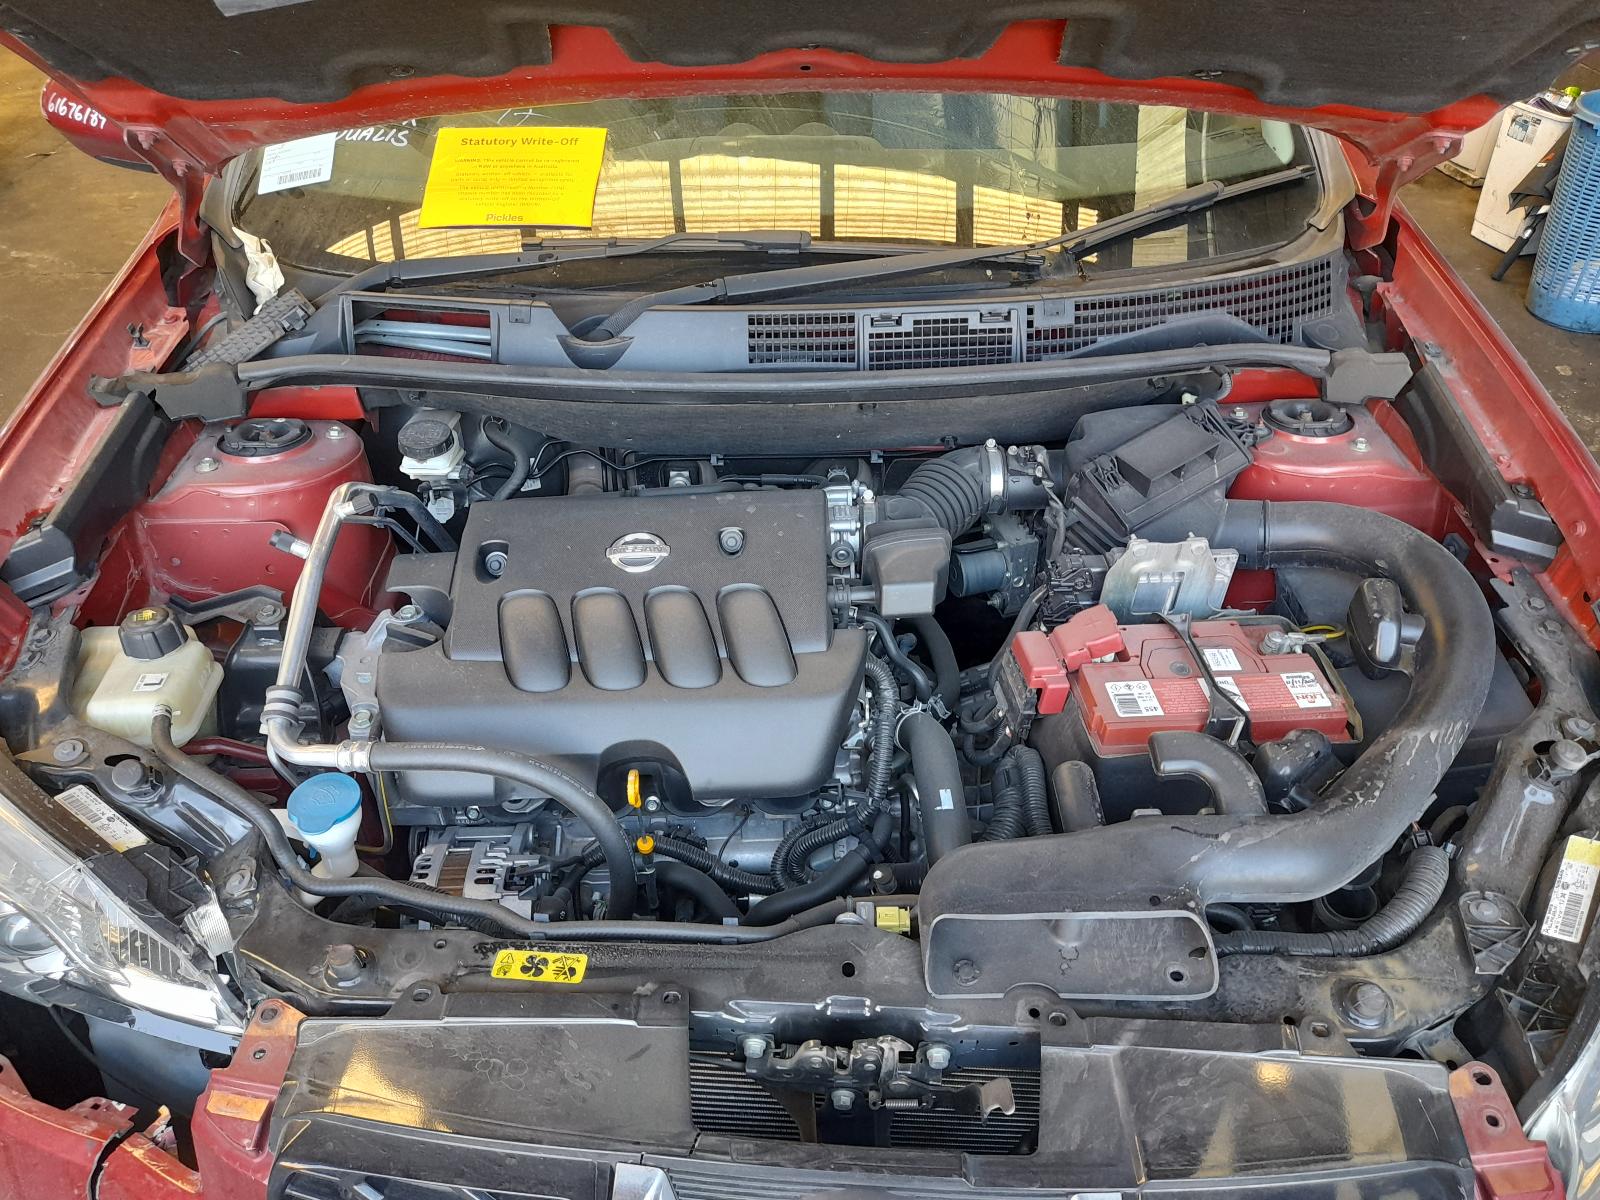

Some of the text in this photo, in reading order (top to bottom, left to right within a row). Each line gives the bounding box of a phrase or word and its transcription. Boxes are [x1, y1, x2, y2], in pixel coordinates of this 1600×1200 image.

[48, 92, 106, 129] 61676187
[461, 137, 579, 147] Statutory Write-Off
[486, 213, 524, 222] Pickles
